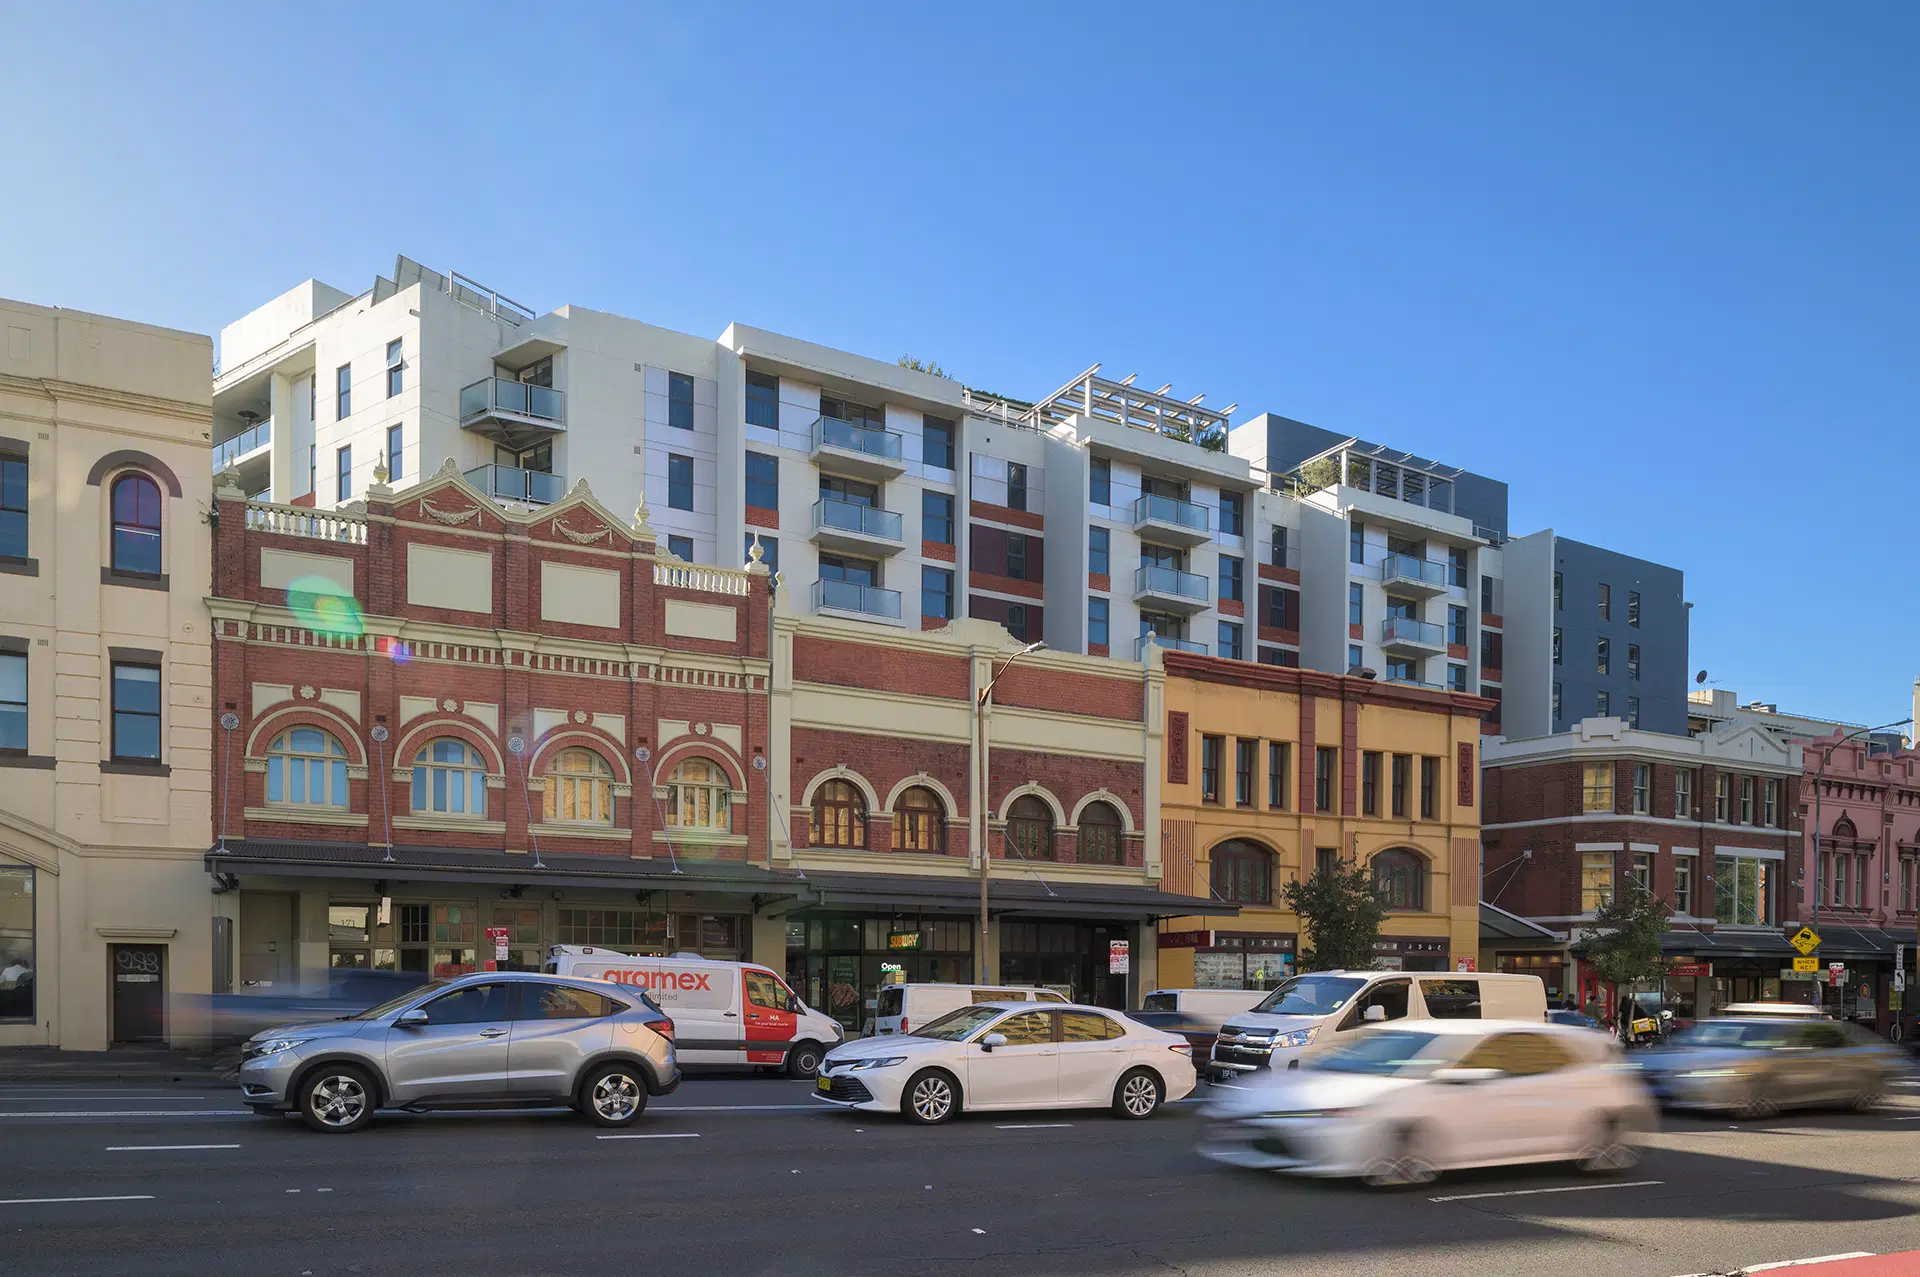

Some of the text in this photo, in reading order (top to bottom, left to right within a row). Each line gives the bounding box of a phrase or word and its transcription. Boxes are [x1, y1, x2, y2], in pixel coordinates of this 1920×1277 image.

[890, 934, 918, 948] SUBWAY
[881, 962, 901, 971] Open
[603, 969, 711, 990] aramex
